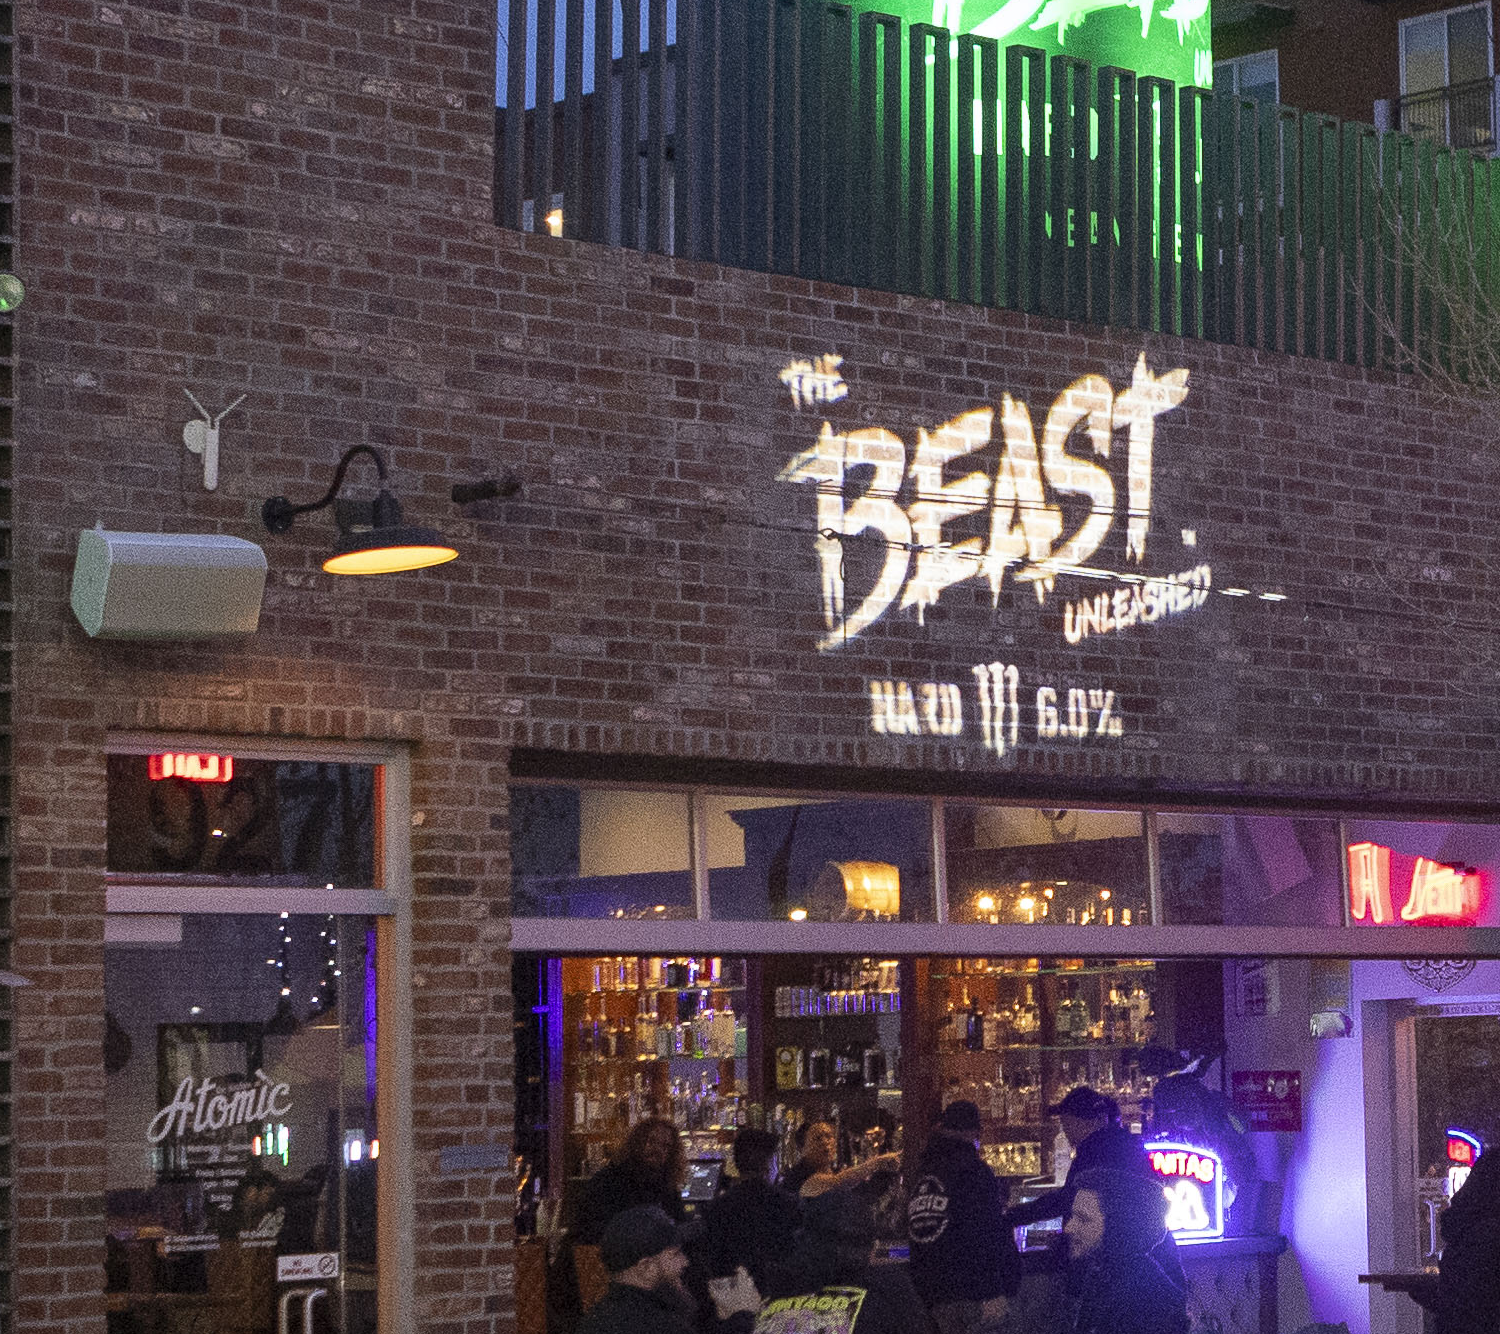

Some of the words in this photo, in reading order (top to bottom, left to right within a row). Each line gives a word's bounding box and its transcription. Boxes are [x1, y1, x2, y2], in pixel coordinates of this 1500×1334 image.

[775, 352, 1190, 654] BEAST
[1063, 565, 1213, 645] UNLEASHED
[148, 1069, 293, 1144] Atomic
